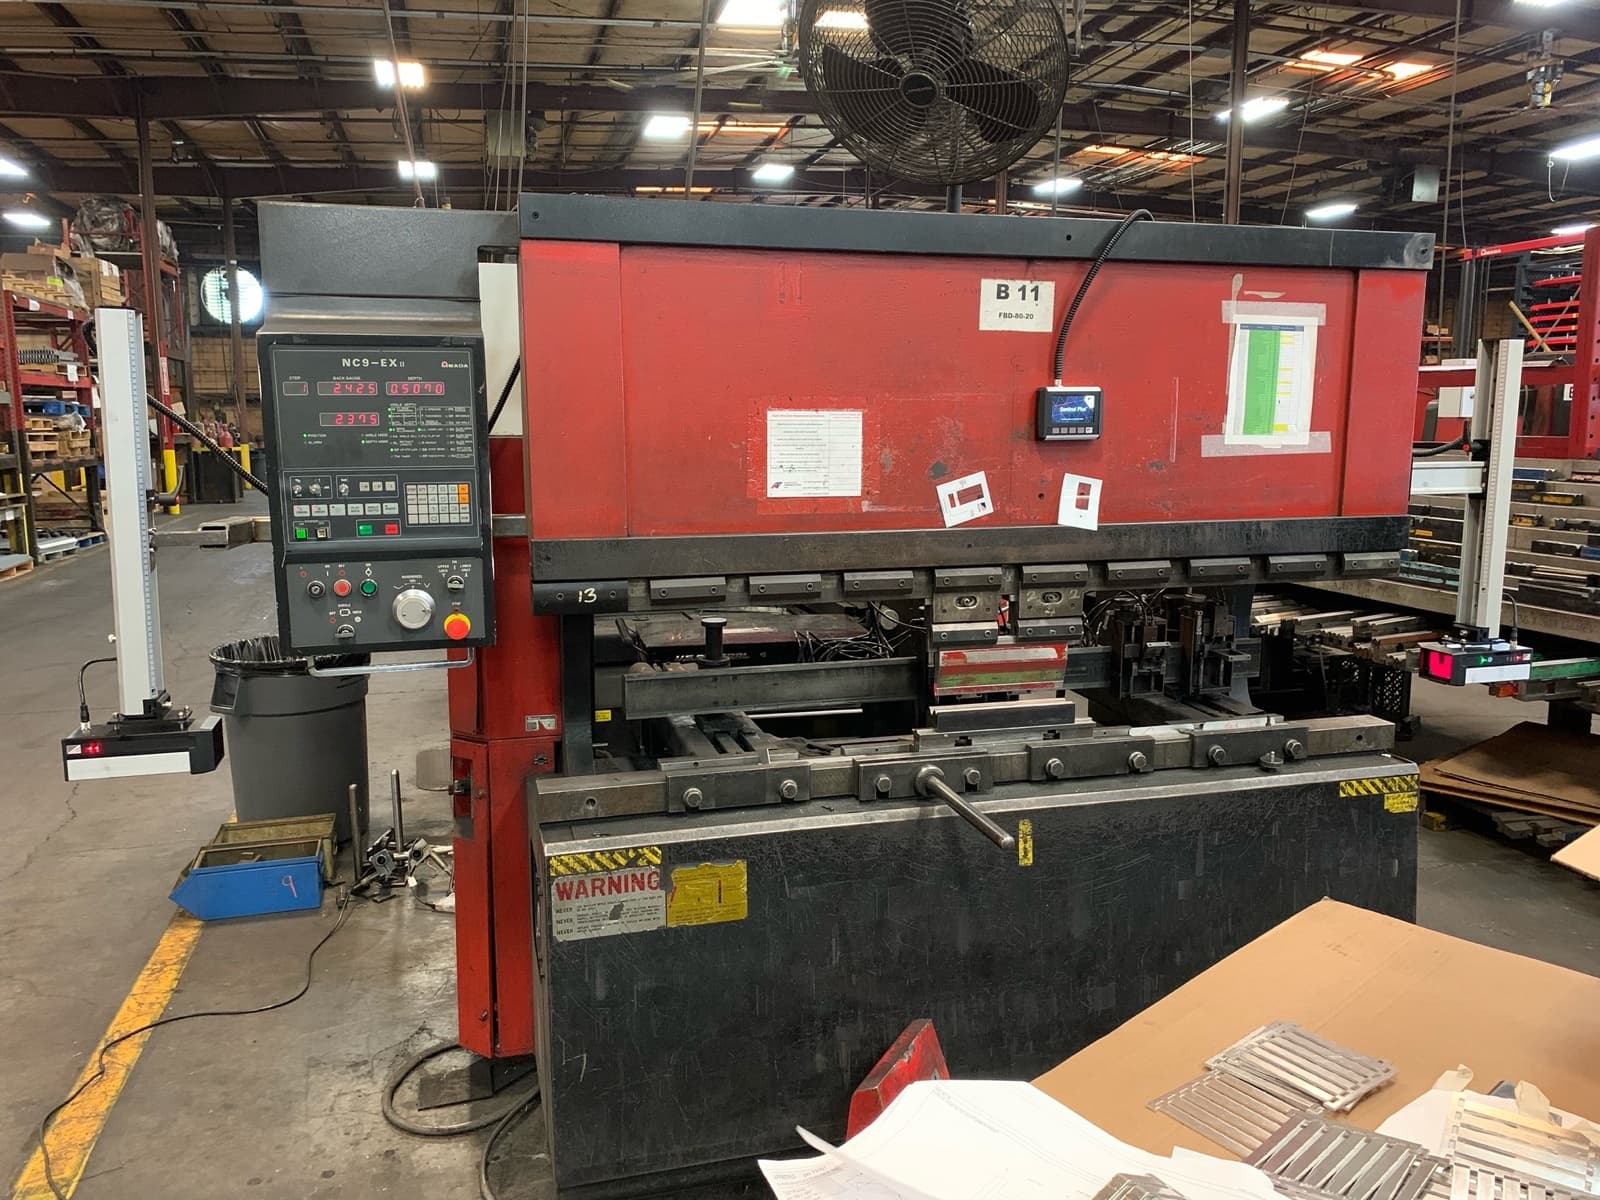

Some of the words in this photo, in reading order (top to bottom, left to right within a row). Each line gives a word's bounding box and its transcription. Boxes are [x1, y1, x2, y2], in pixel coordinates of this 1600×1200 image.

[996, 283, 1010, 300] B
[1017, 284, 1040, 302] 11
[998, 311, 1035, 320] FBD-80-20
[341, 358, 398, 368] NC9-EX
[578, 587, 597, 603] 13
[555, 870, 660, 901] WARNING
